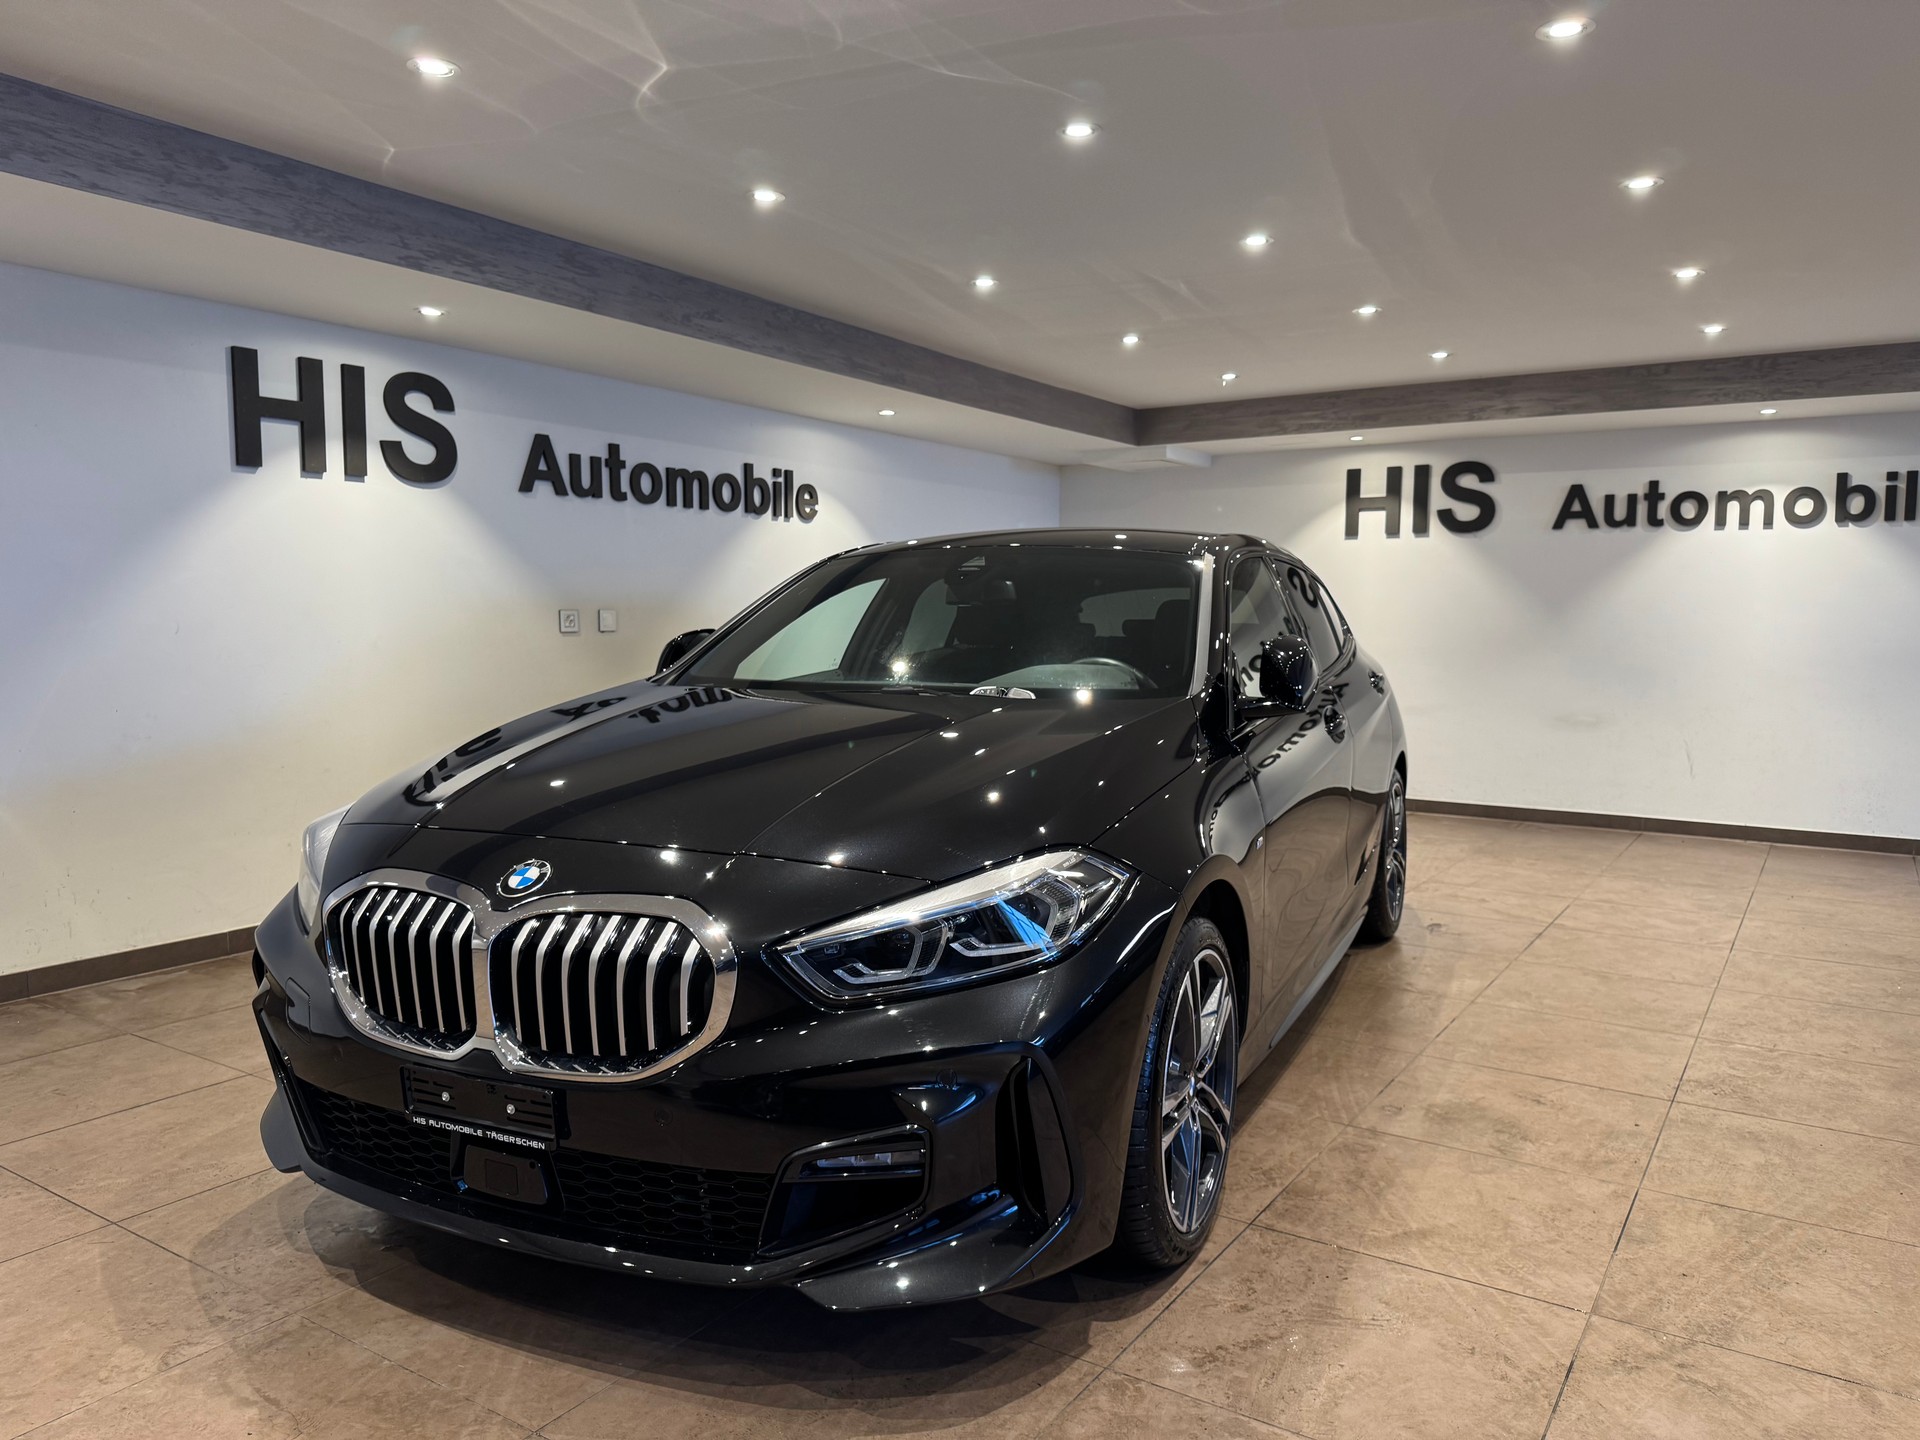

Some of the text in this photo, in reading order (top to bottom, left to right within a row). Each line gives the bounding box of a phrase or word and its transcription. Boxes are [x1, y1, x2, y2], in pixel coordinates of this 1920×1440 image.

[230, 346, 819, 521] HIS Automobile
[1344, 460, 1919, 539] HIS Automobil
[413, 1116, 546, 1150] HIS AUTOMOBILE TÄGERSCHEN
